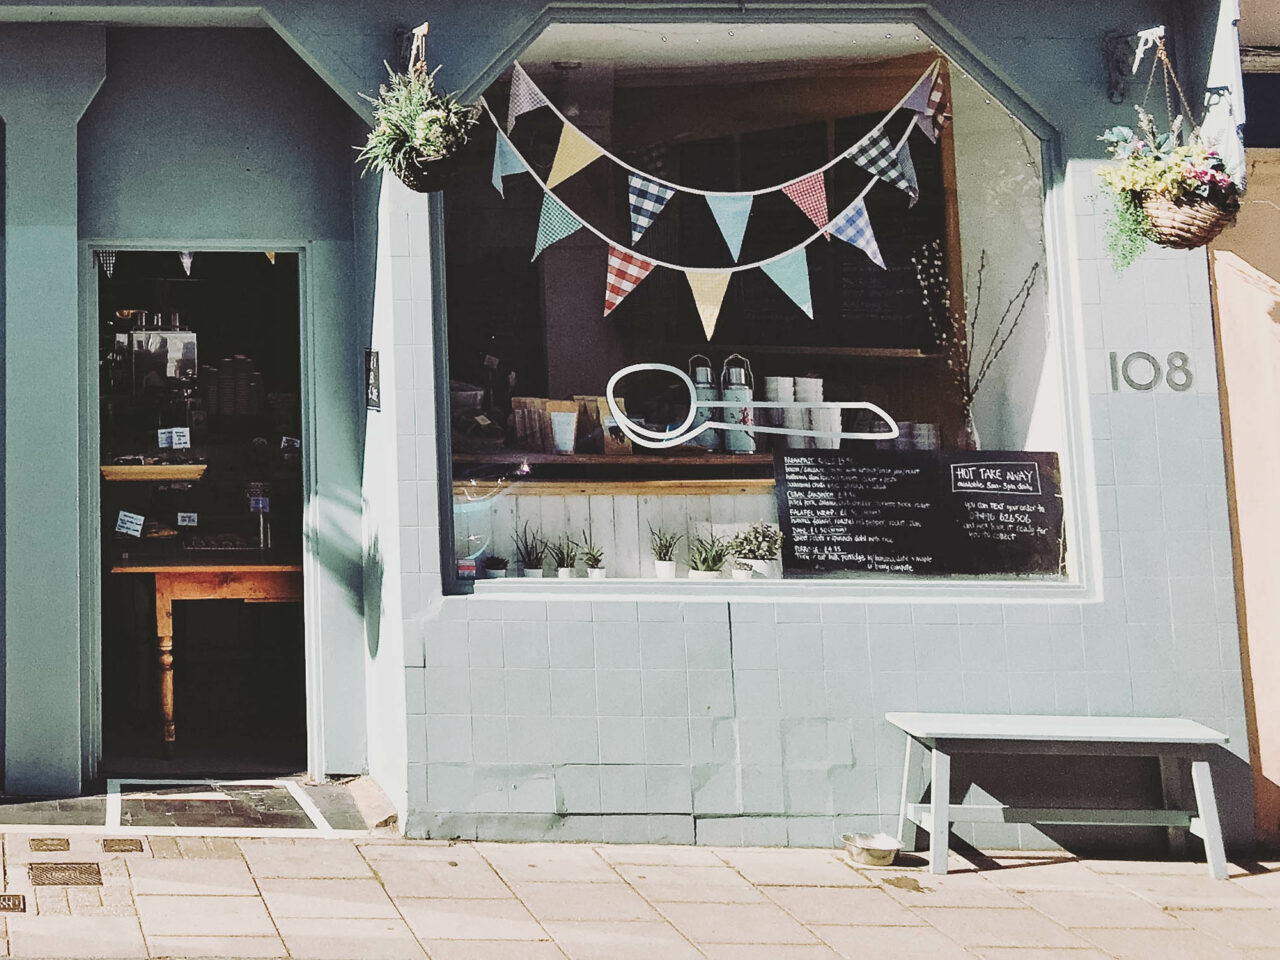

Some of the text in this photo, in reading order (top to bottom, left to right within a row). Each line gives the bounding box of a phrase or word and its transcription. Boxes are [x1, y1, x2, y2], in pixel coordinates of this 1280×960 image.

[1109, 351, 1193, 392] 108
[956, 467, 1033, 483] HOT TAKE AWAY
[999, 513, 1032, 524] 626506
